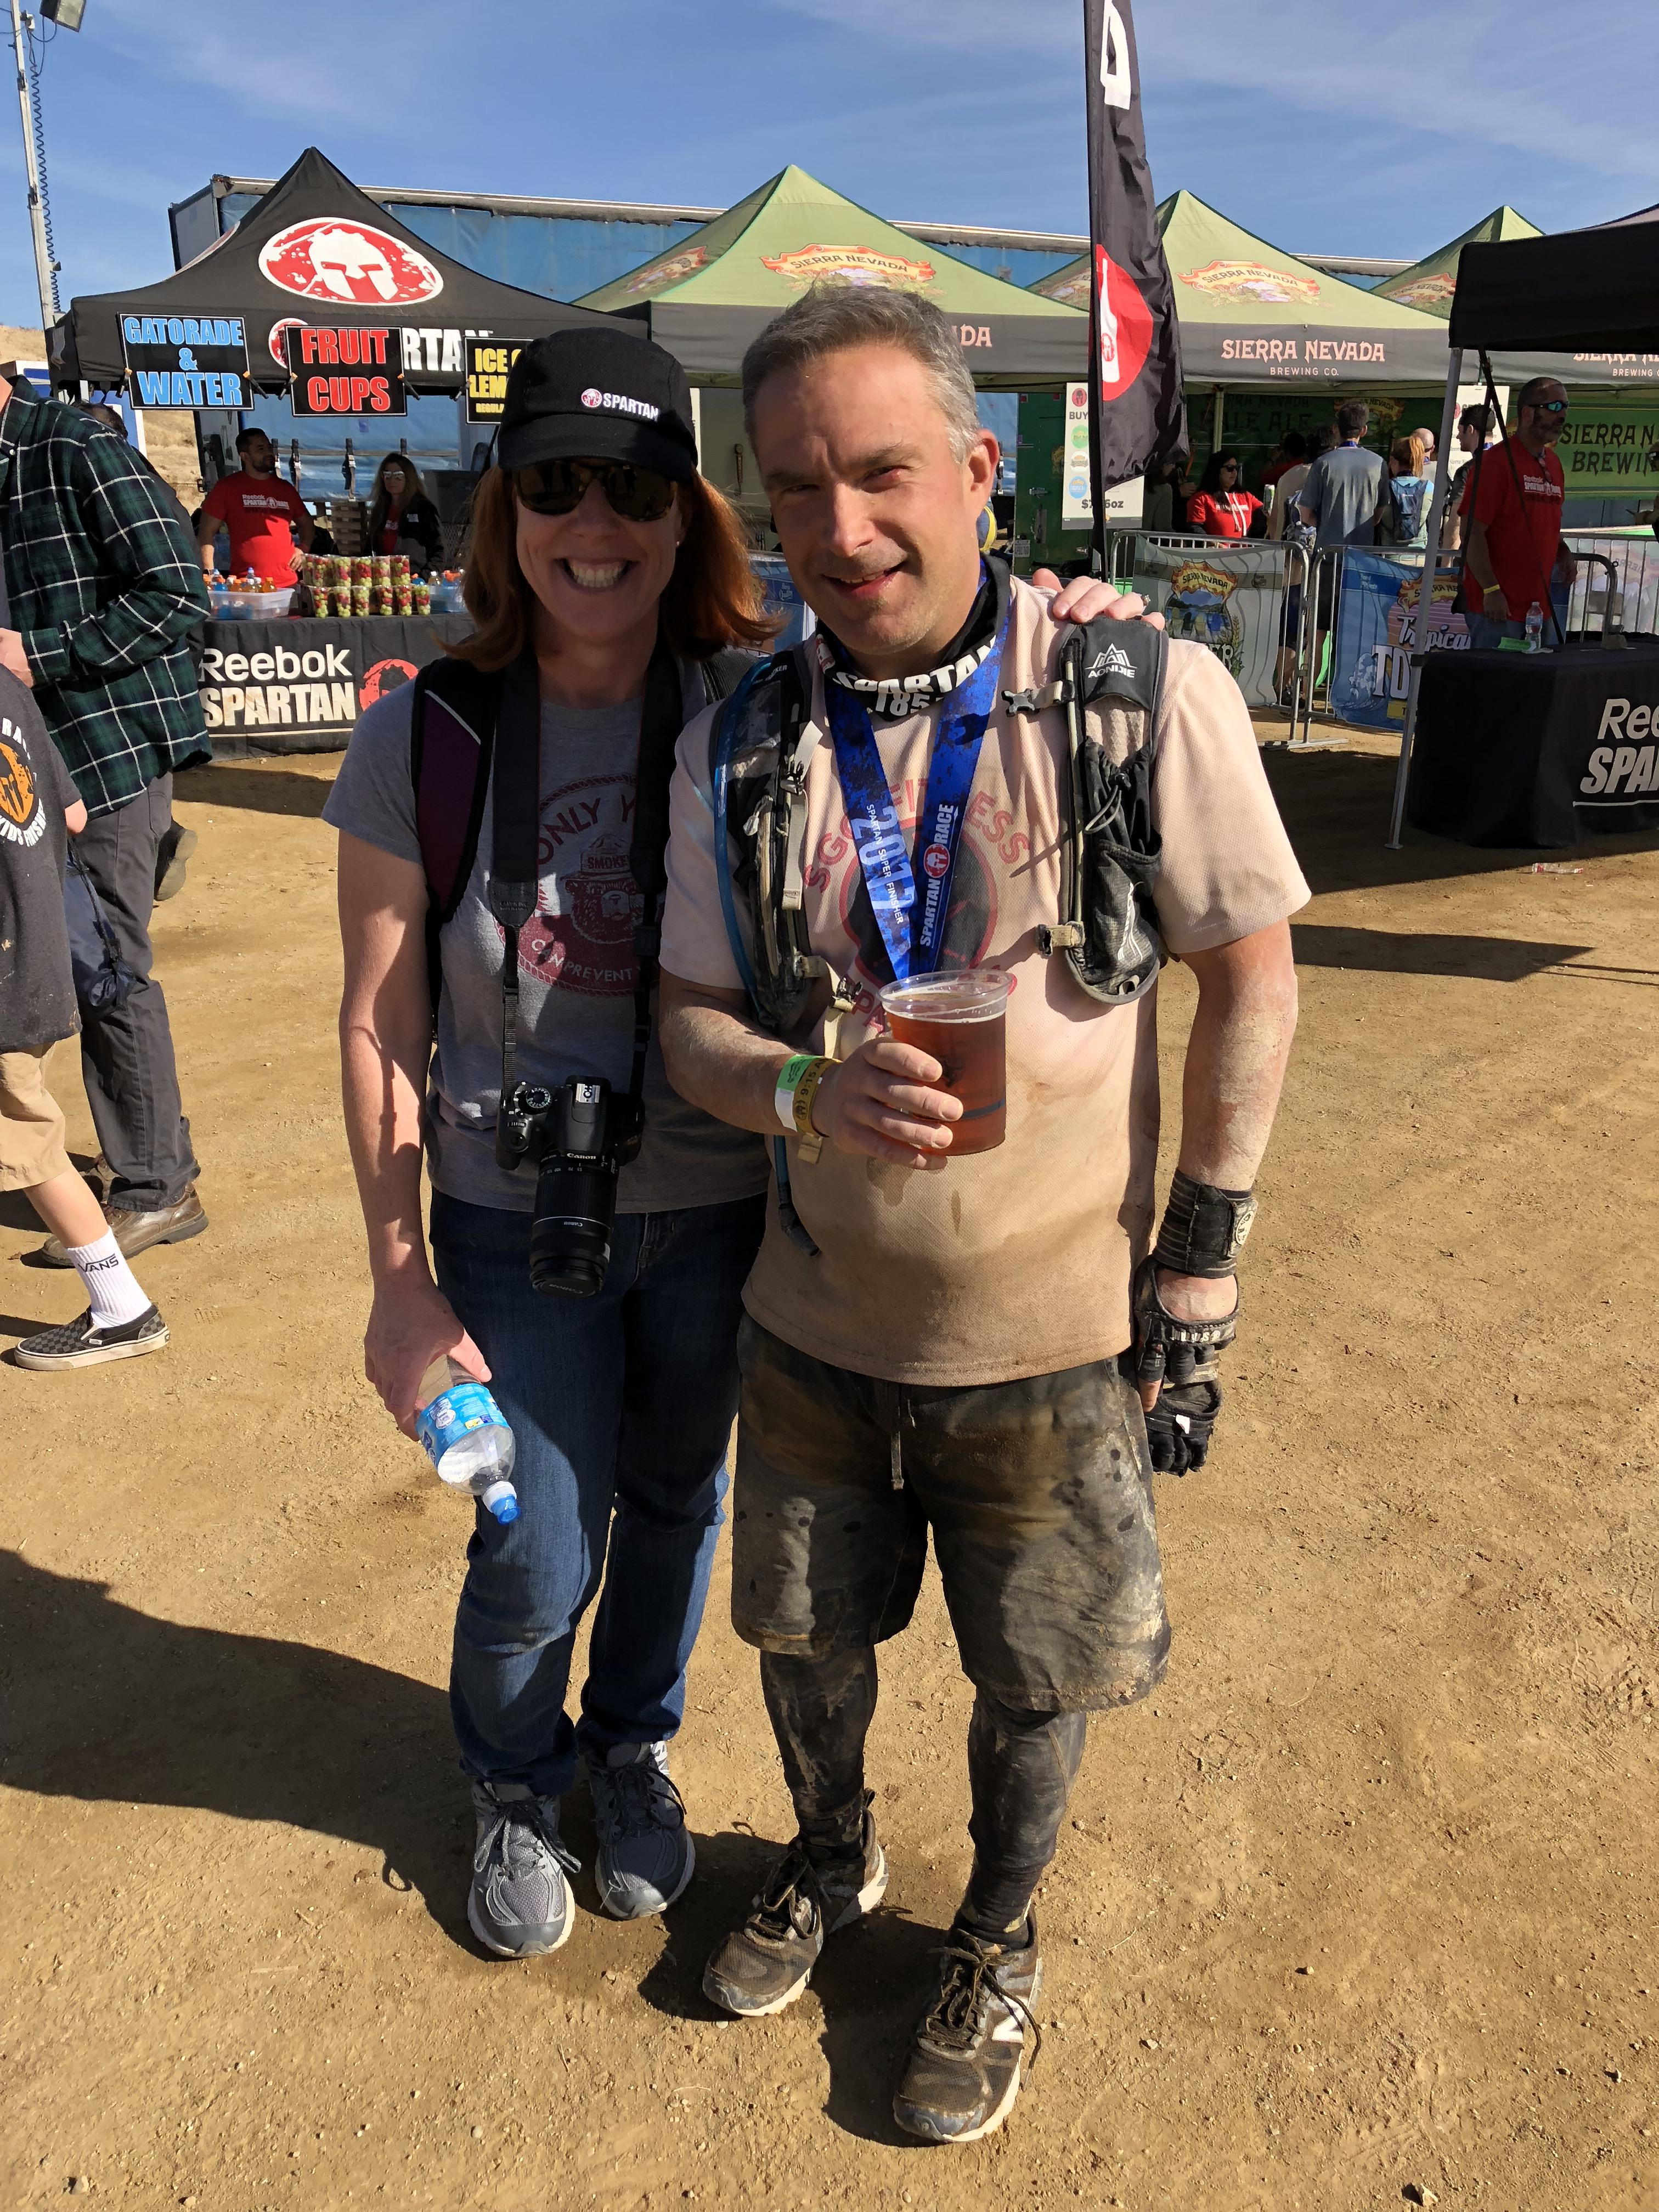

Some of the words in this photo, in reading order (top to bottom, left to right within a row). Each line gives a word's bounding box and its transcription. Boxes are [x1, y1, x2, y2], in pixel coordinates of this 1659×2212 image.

[791, 255, 843, 269] SIERRA
[845, 255, 908, 272] NEVADA
[1202, 270, 1246, 284] SIERRA
[1248, 270, 1298, 287] NEVADA
[124, 317, 244, 346] GATORADE
[179, 347, 198, 371] &
[300, 328, 389, 364] FRUIT
[1221, 338, 1297, 363] SIERRA
[1304, 339, 1385, 364] NEVADA
[475, 348, 508, 373] ICE
[1269, 366, 1319, 376] BREWING
[1323, 368, 1340, 376] CO.
[1612, 368, 1653, 377] BREWING
[137, 371, 242, 405] WATER
[308, 376, 391, 411] CUPS
[603, 393, 659, 422] SPARTAN
[1069, 411, 1088, 420] BUY
[1559, 423, 1637, 449] SIERRA
[1200, 573, 1228, 589] NEVADA
[199, 644, 352, 682] Reebok
[1088, 664, 1135, 678] AONIJIE
[199, 682, 356, 727] SPARTAN
[850, 805, 916, 911] 2017
[867, 804, 883, 845] SPARTAN
[878, 849, 891, 878] SUPER
[886, 882, 904, 924] FINISHER
[920, 879, 941, 947] SPARTAN
[934, 804, 954, 844] RACE
[532, 939, 564, 968] CAN
[566, 962, 633, 981] PREVENT
